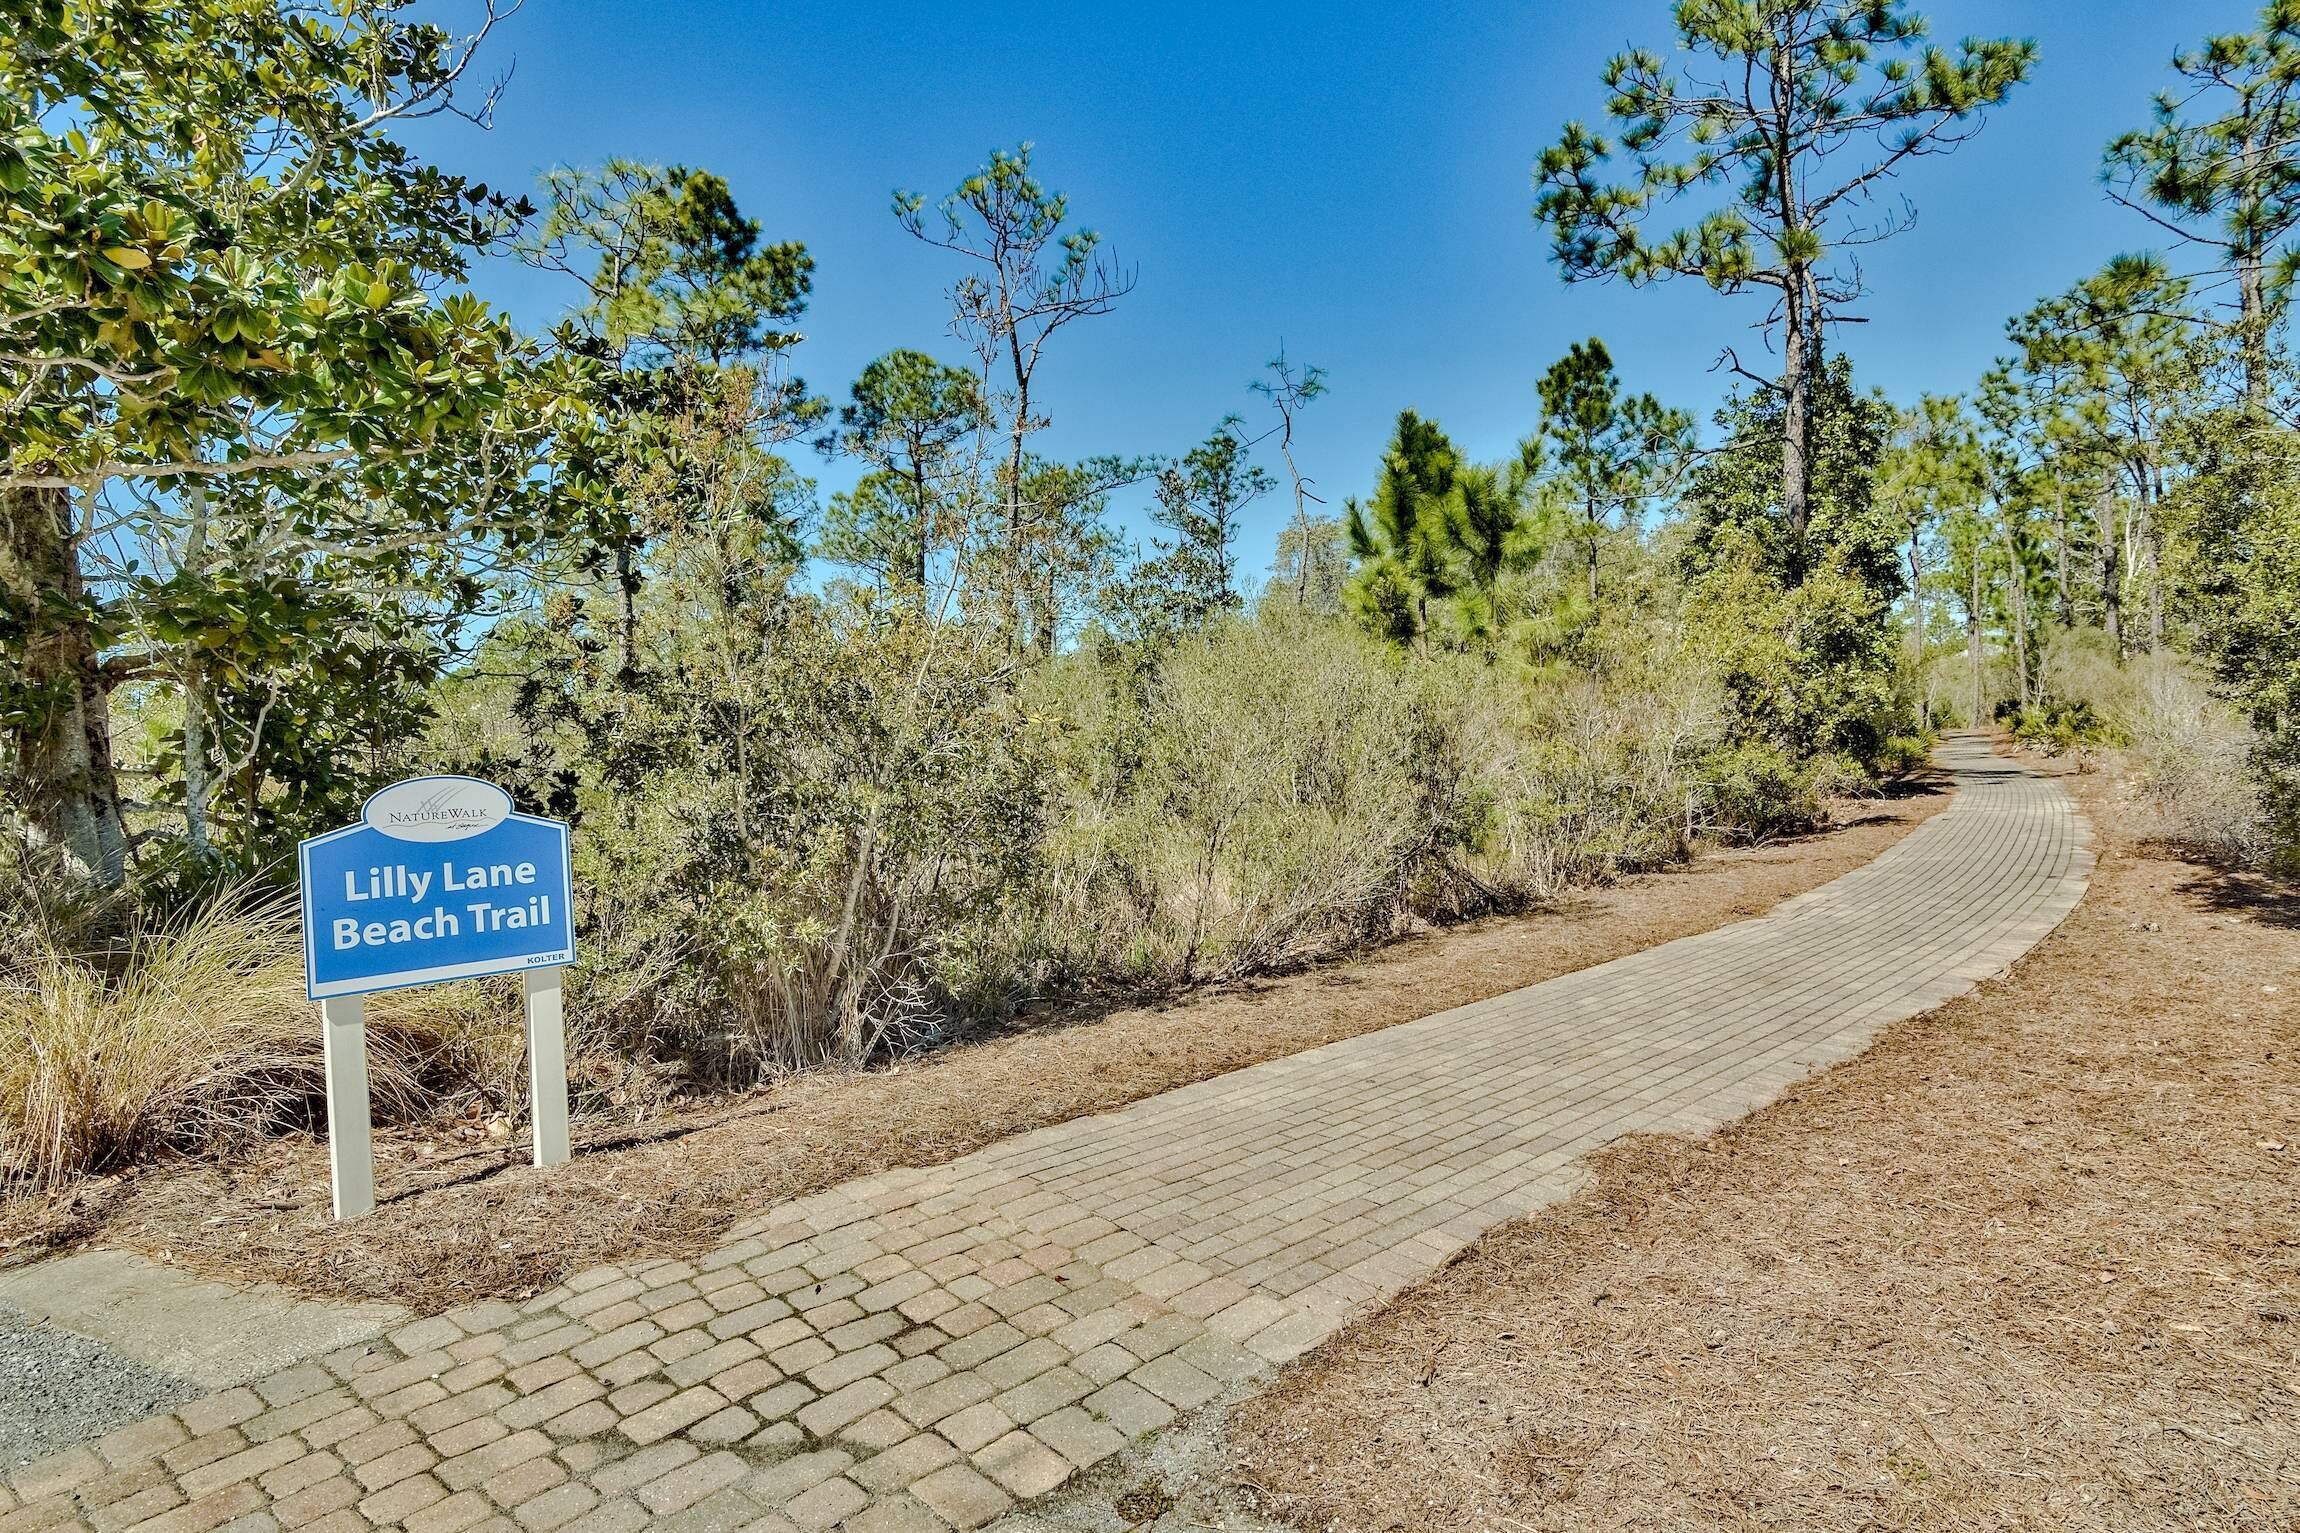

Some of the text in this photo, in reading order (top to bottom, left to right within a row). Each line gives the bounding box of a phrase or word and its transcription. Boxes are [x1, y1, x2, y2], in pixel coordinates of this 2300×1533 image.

[345, 861, 537, 904] Lilly Lane
[332, 895, 551, 951] Beach Trail
[527, 953, 565, 964] KOLTER
